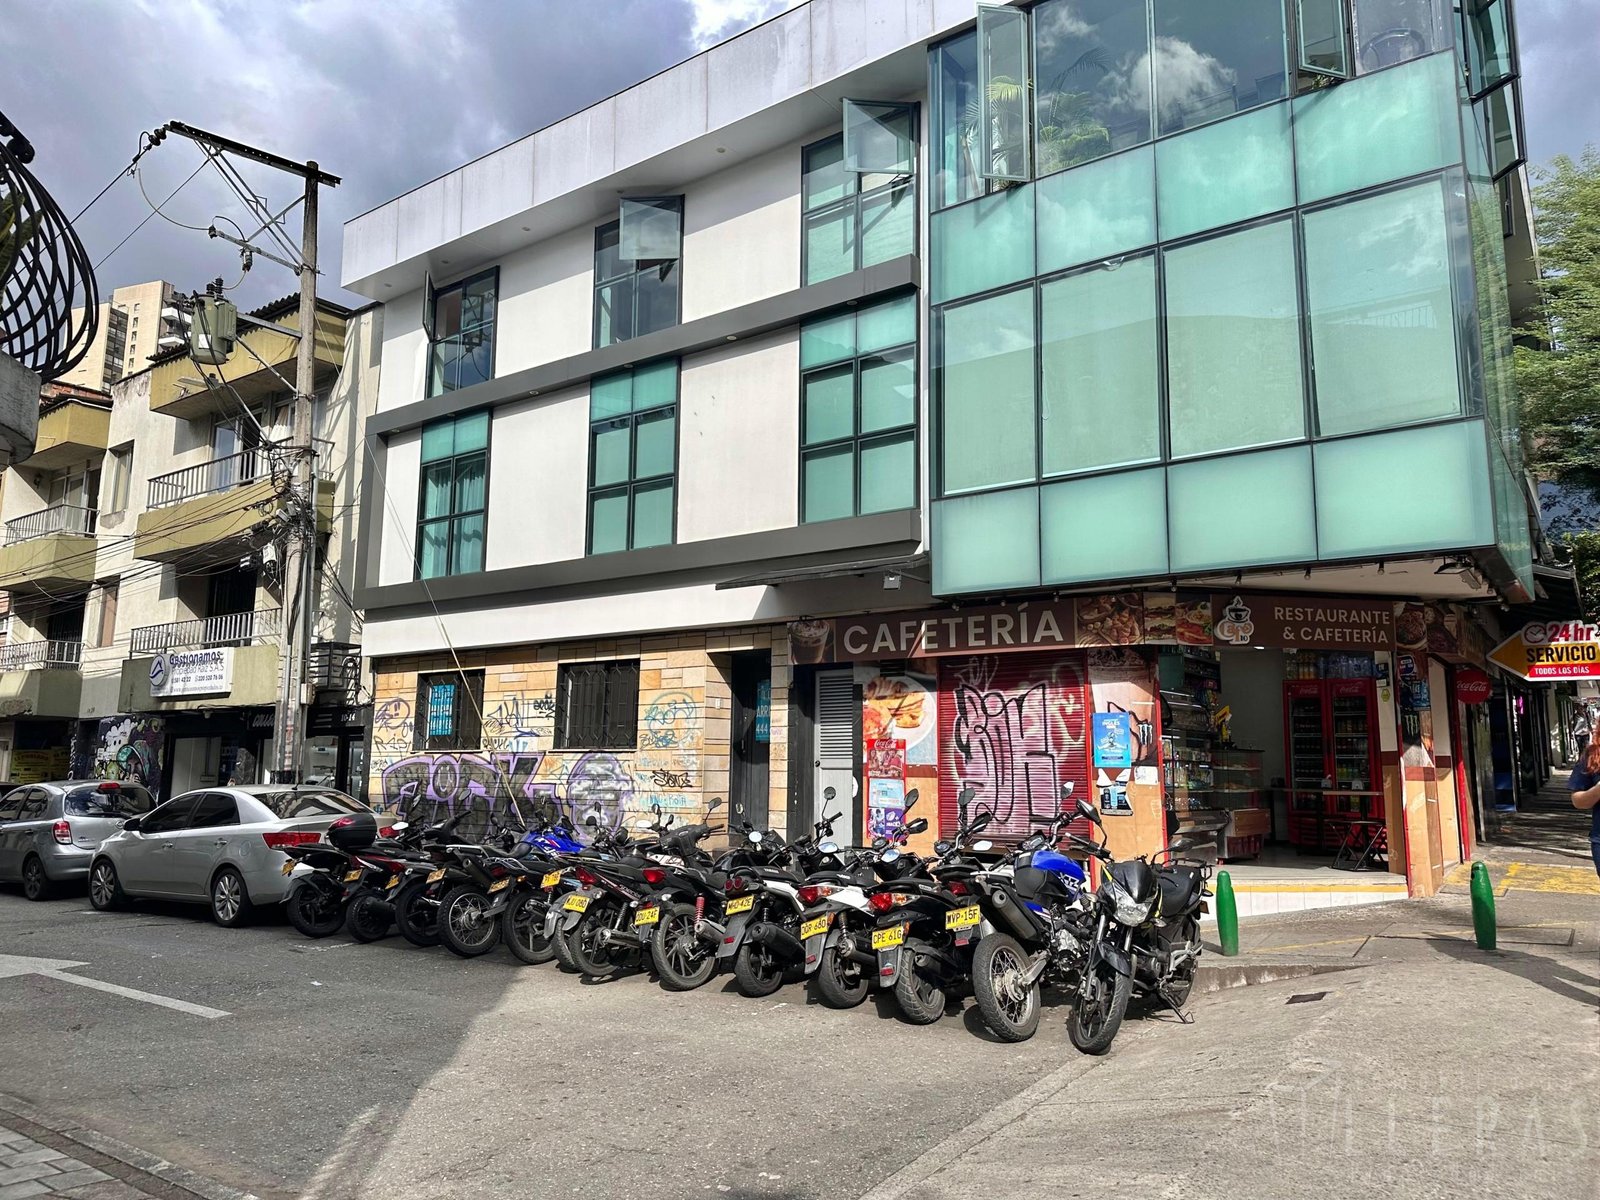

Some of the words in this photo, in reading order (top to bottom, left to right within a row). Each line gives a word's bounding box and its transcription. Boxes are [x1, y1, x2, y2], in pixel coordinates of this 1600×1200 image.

[1274, 606, 1391, 625] RESTAURANTE
[843, 601, 1063, 655] CAFETERÍA
[1283, 626, 1296, 640] &
[1300, 626, 1389, 643] CAFETERÍA
[169, 650, 221, 666] Gestionamos
[1526, 646, 1596, 663] SERVICIO
[1535, 667, 1556, 675] TODOS
[1558, 666, 1572, 674] LOS
[1573, 666, 1590, 674] DÍAS
[873, 933, 886, 944] CPE
